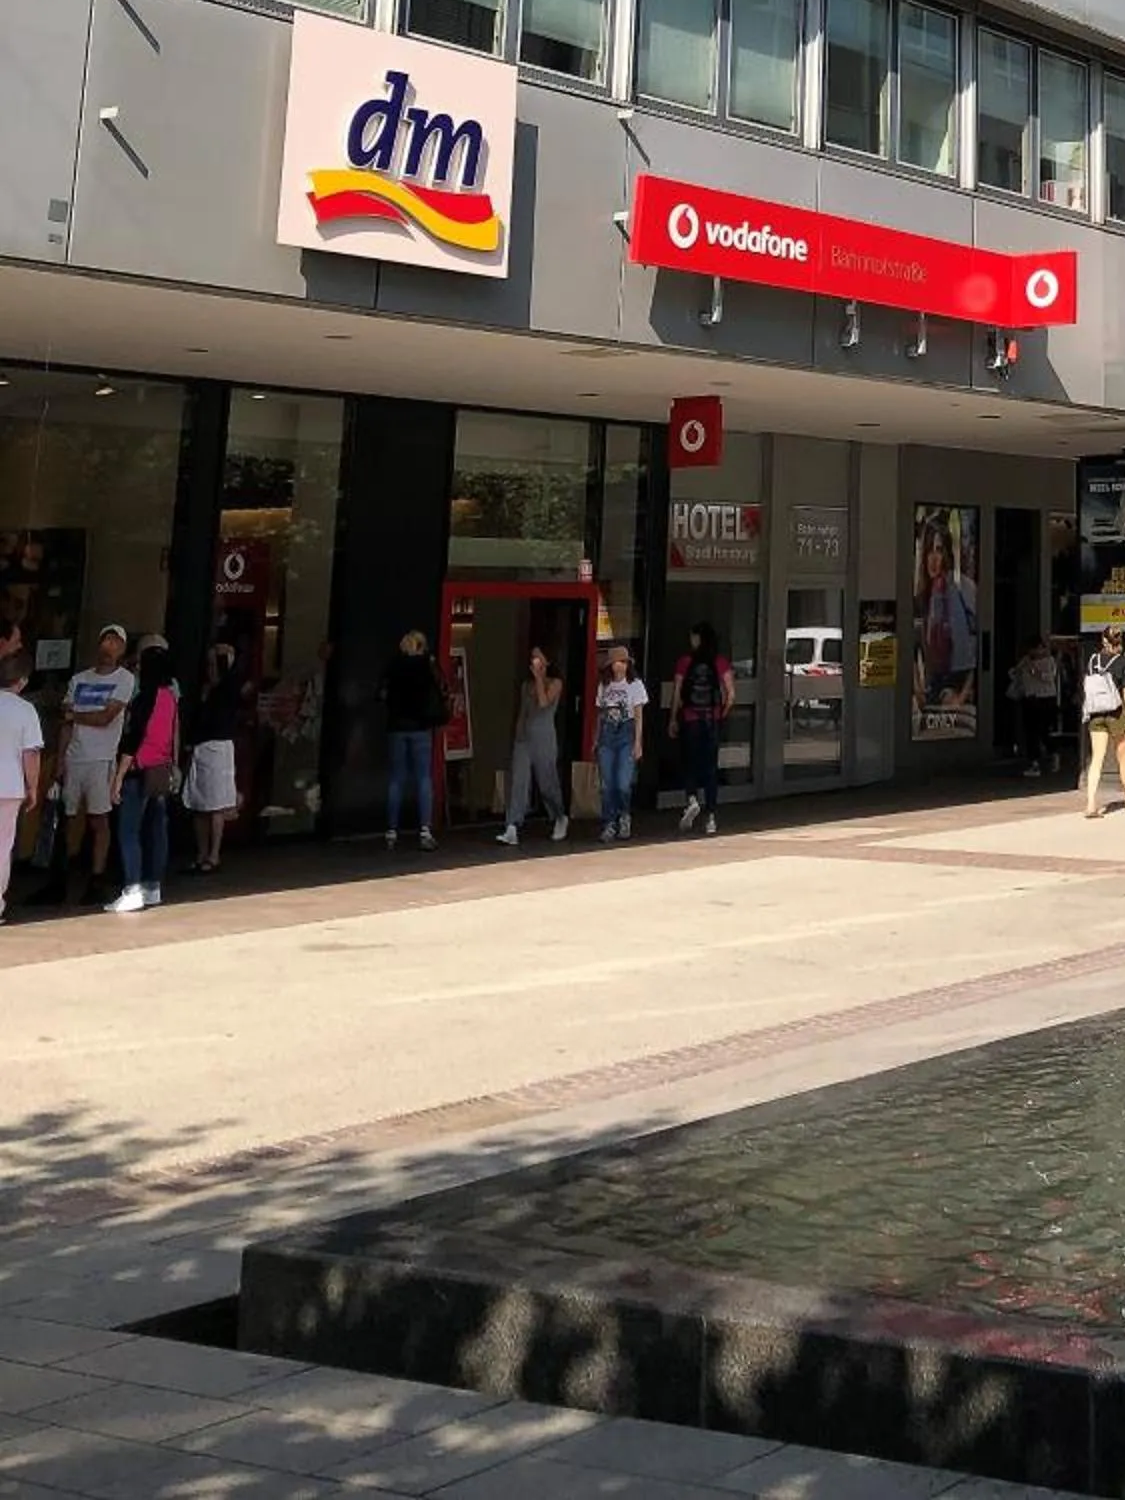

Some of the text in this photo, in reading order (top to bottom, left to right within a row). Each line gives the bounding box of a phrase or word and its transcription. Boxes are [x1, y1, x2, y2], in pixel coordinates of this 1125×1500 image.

[347, 70, 483, 187] dm
[705, 220, 809, 262] vodafone
[672, 503, 750, 542] HOTEL
